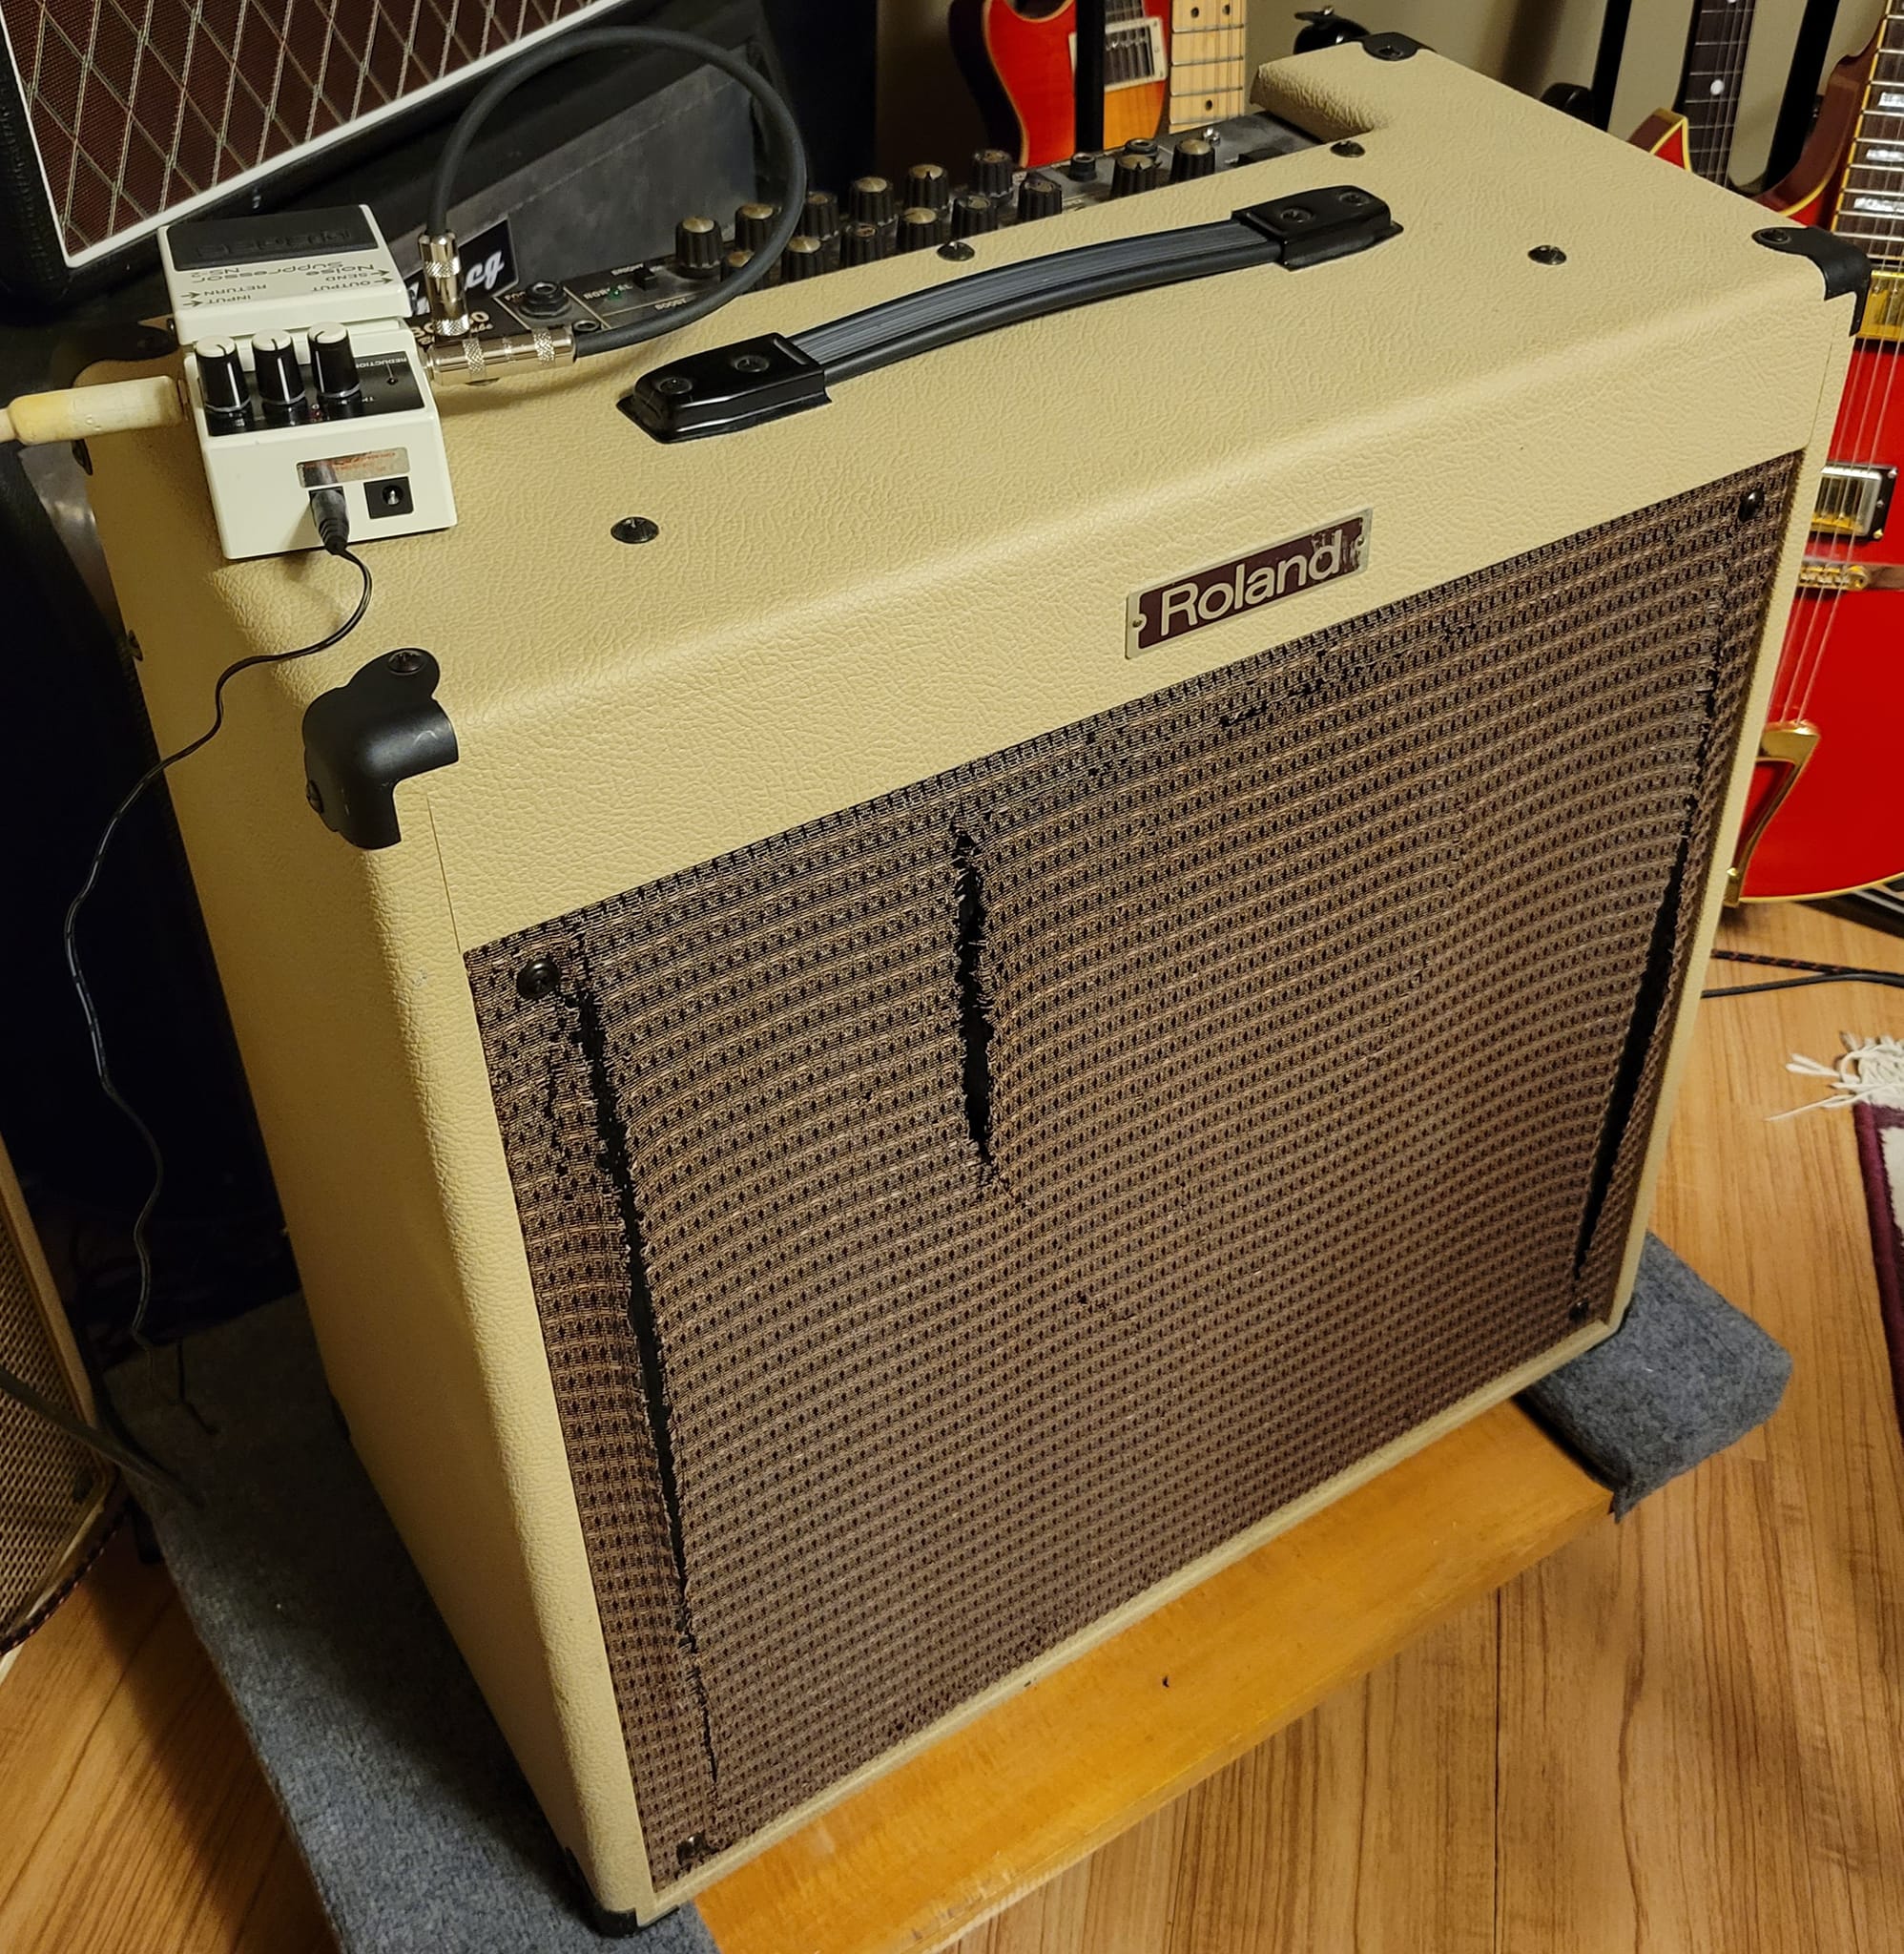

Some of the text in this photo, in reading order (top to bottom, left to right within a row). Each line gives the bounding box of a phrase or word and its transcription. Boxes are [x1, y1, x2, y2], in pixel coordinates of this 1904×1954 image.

[191, 267, 239, 278] NS-2
[192, 261, 343, 283] Suppressor
[305, 264, 375, 277] Noise
[325, 273, 368, 281] SEND
[204, 284, 267, 297] RETURN
[313, 281, 371, 292] OUTPUT
[207, 295, 251, 305] INPUT
[1160, 529, 1343, 636] Roland
